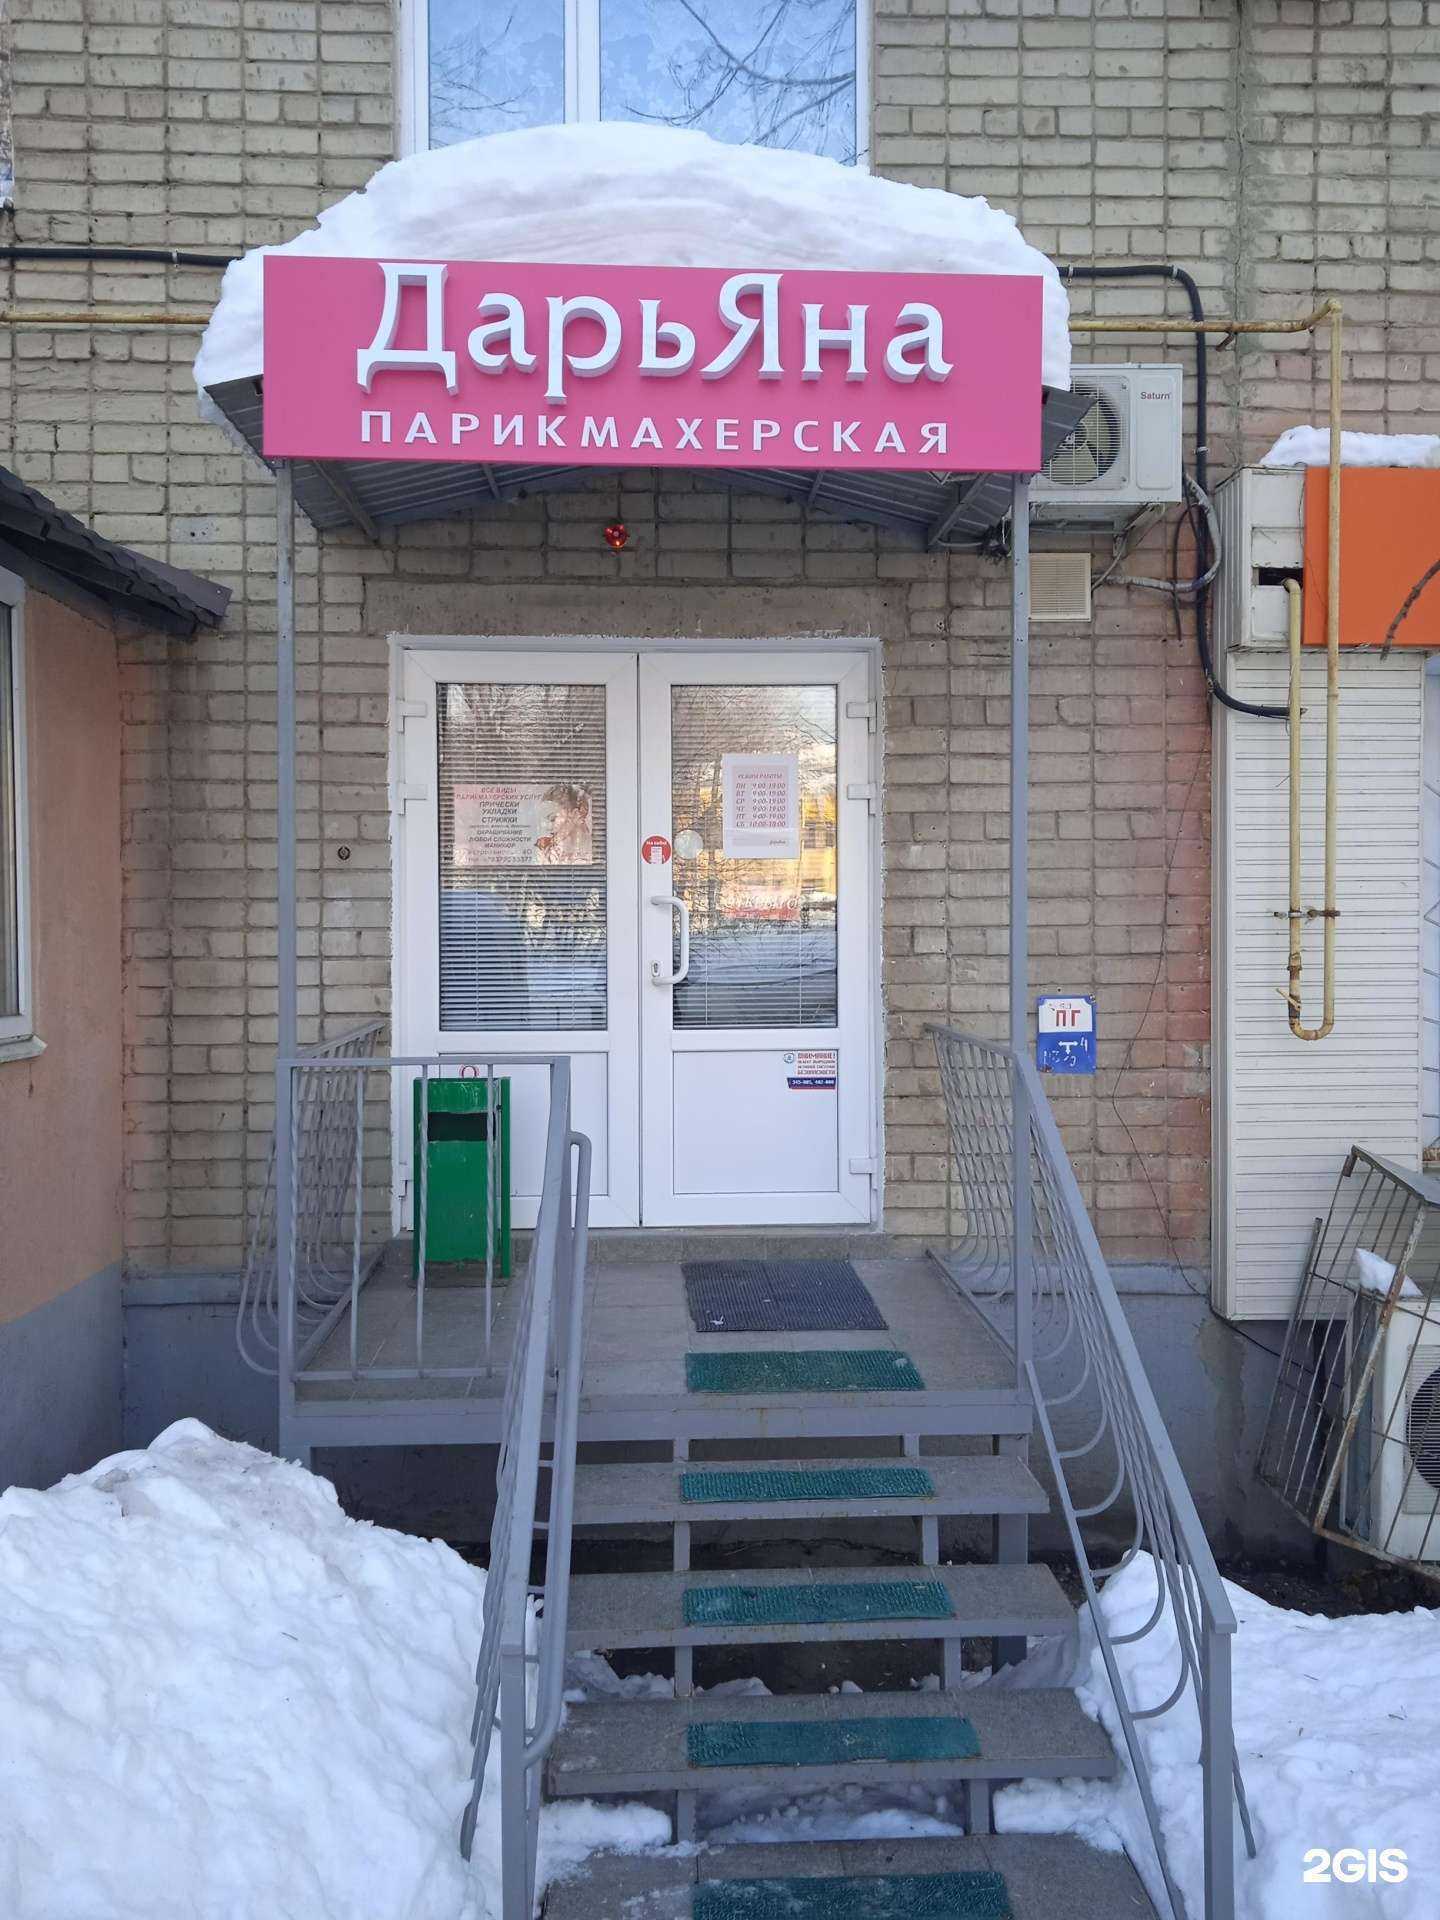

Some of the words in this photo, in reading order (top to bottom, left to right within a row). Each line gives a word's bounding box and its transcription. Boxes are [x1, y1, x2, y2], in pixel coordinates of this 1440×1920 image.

[356, 262, 955, 406] ДарьЯна
[1140, 391, 1171, 400] Saturn
[360, 410, 948, 454] ПАРИКМАХЕРСКАЯ
[1056, 1010, 1081, 1027] ПГ
